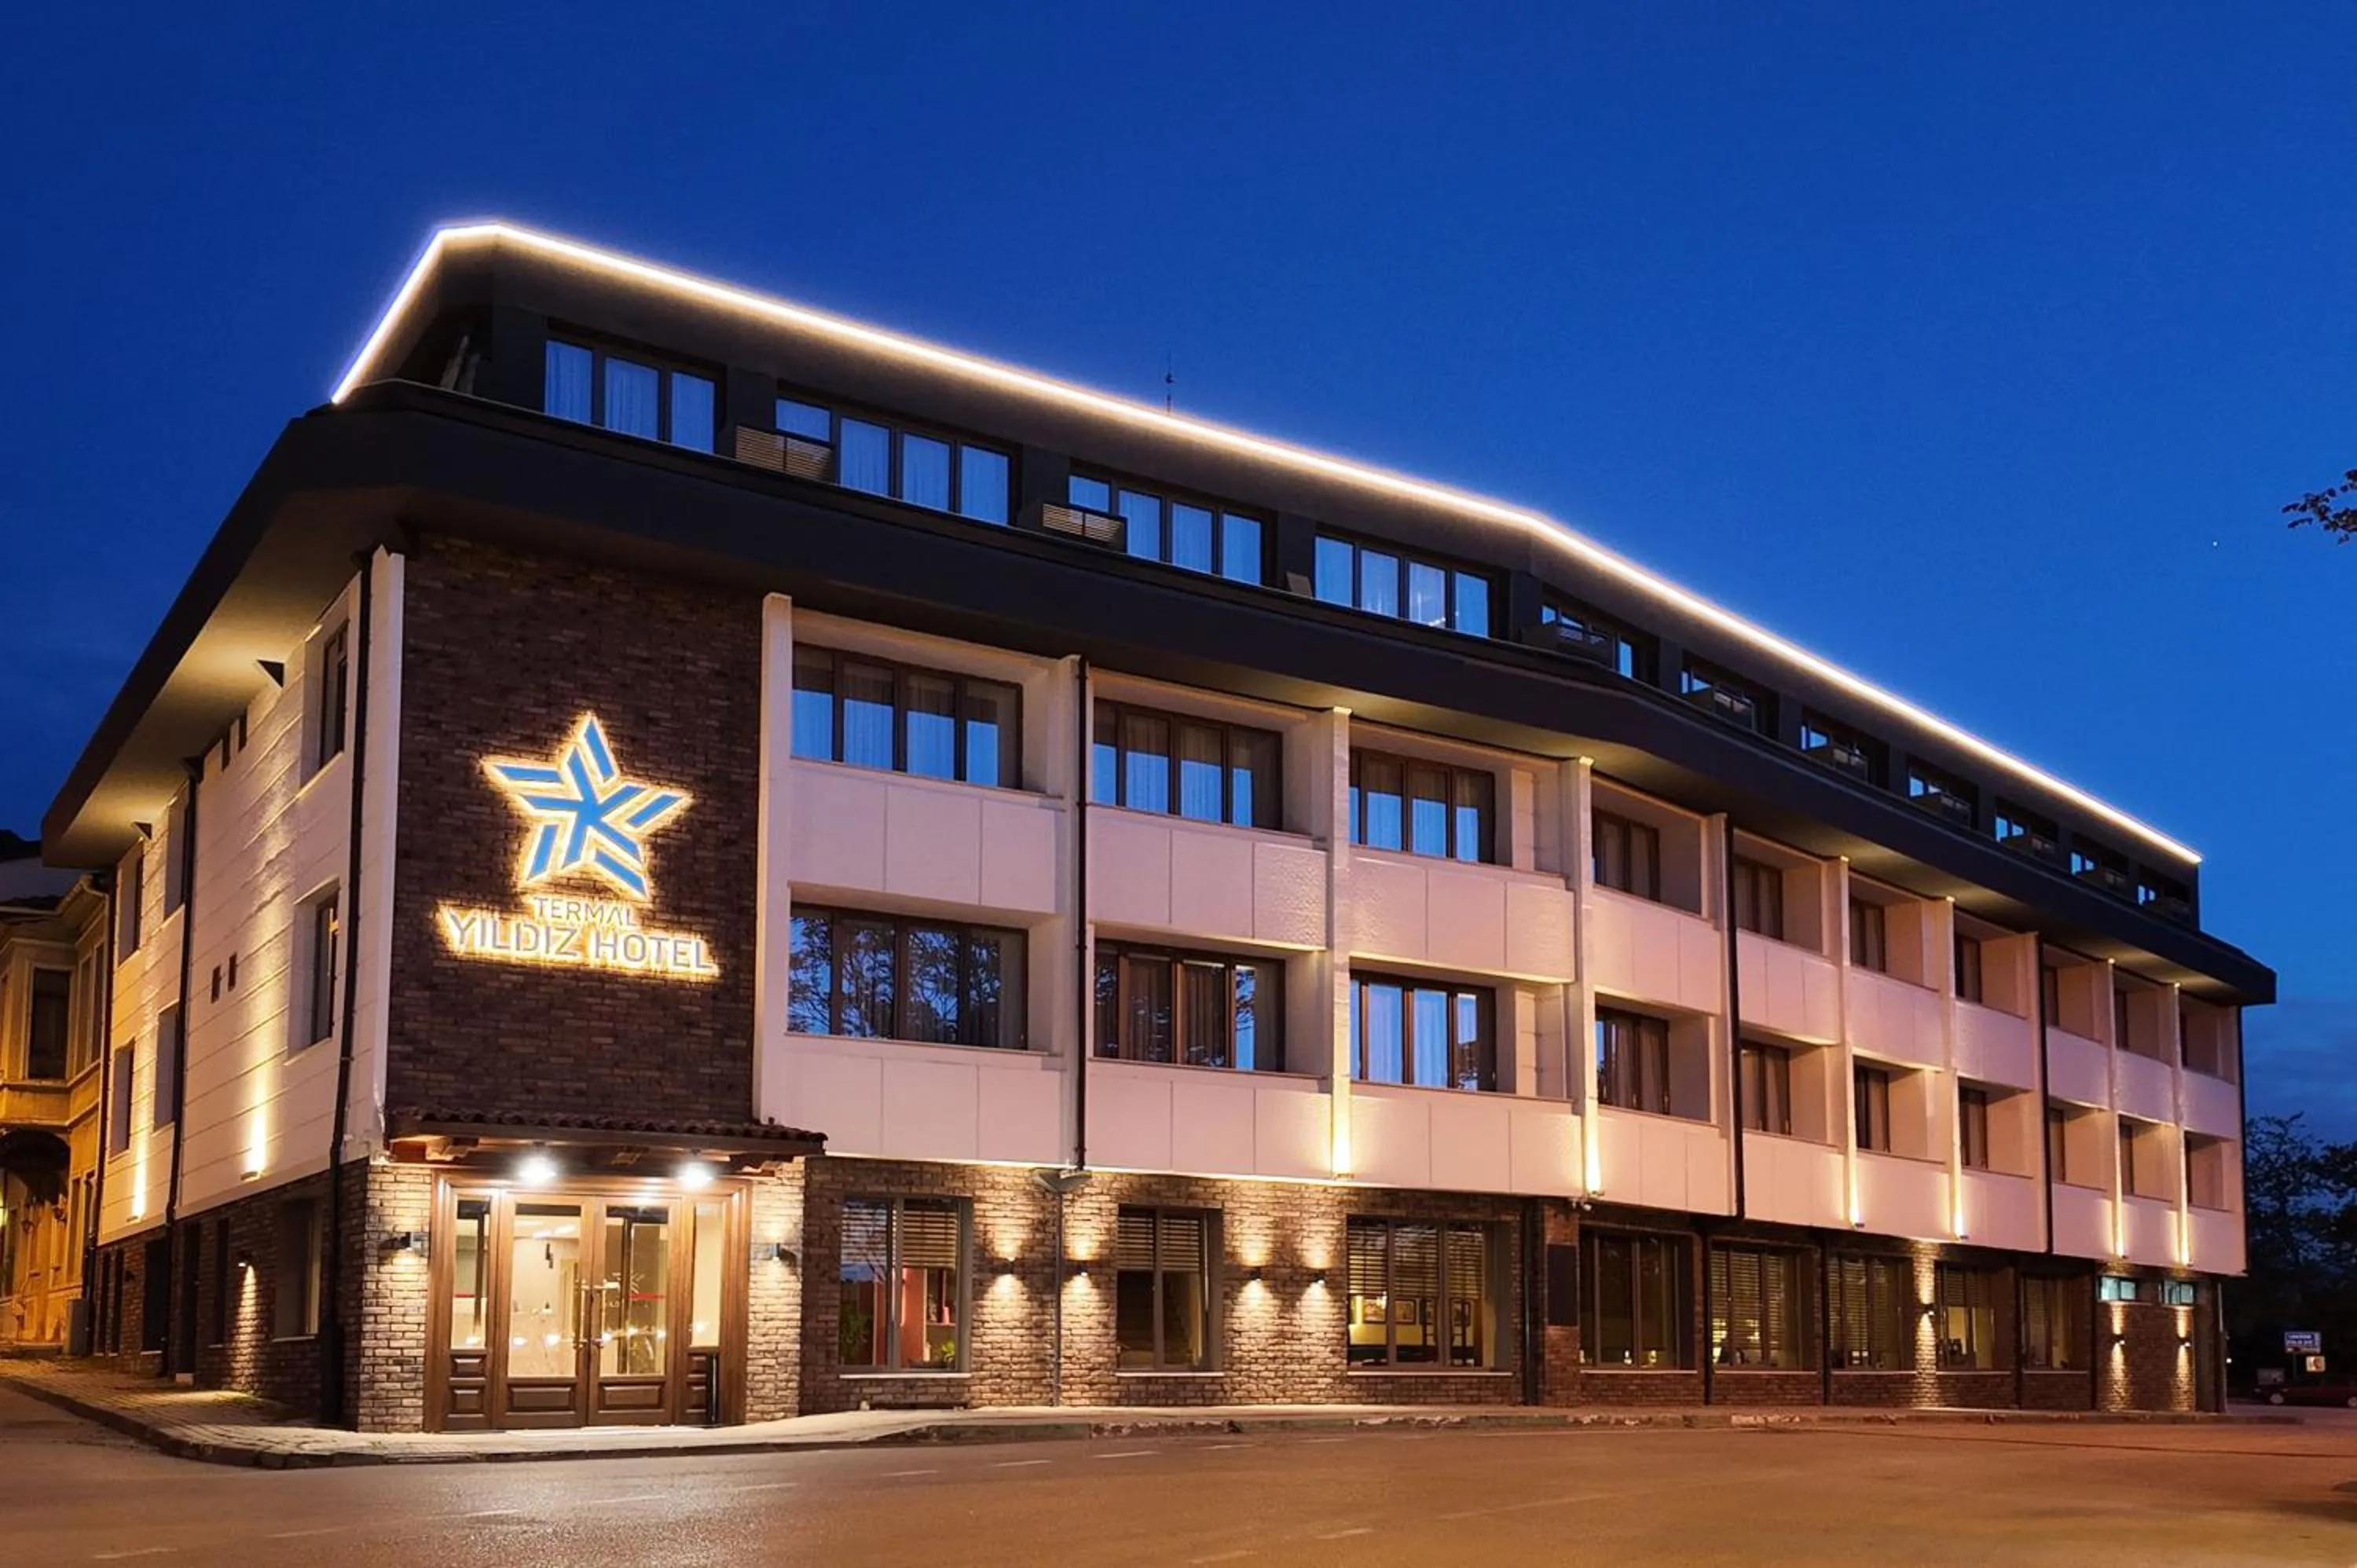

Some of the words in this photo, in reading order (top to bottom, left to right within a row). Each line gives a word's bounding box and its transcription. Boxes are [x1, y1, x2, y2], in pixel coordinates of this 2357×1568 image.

[533, 896, 636, 926] TERMAL
[449, 911, 577, 957] YILDIZ
[595, 930, 713, 969] HOTEL
